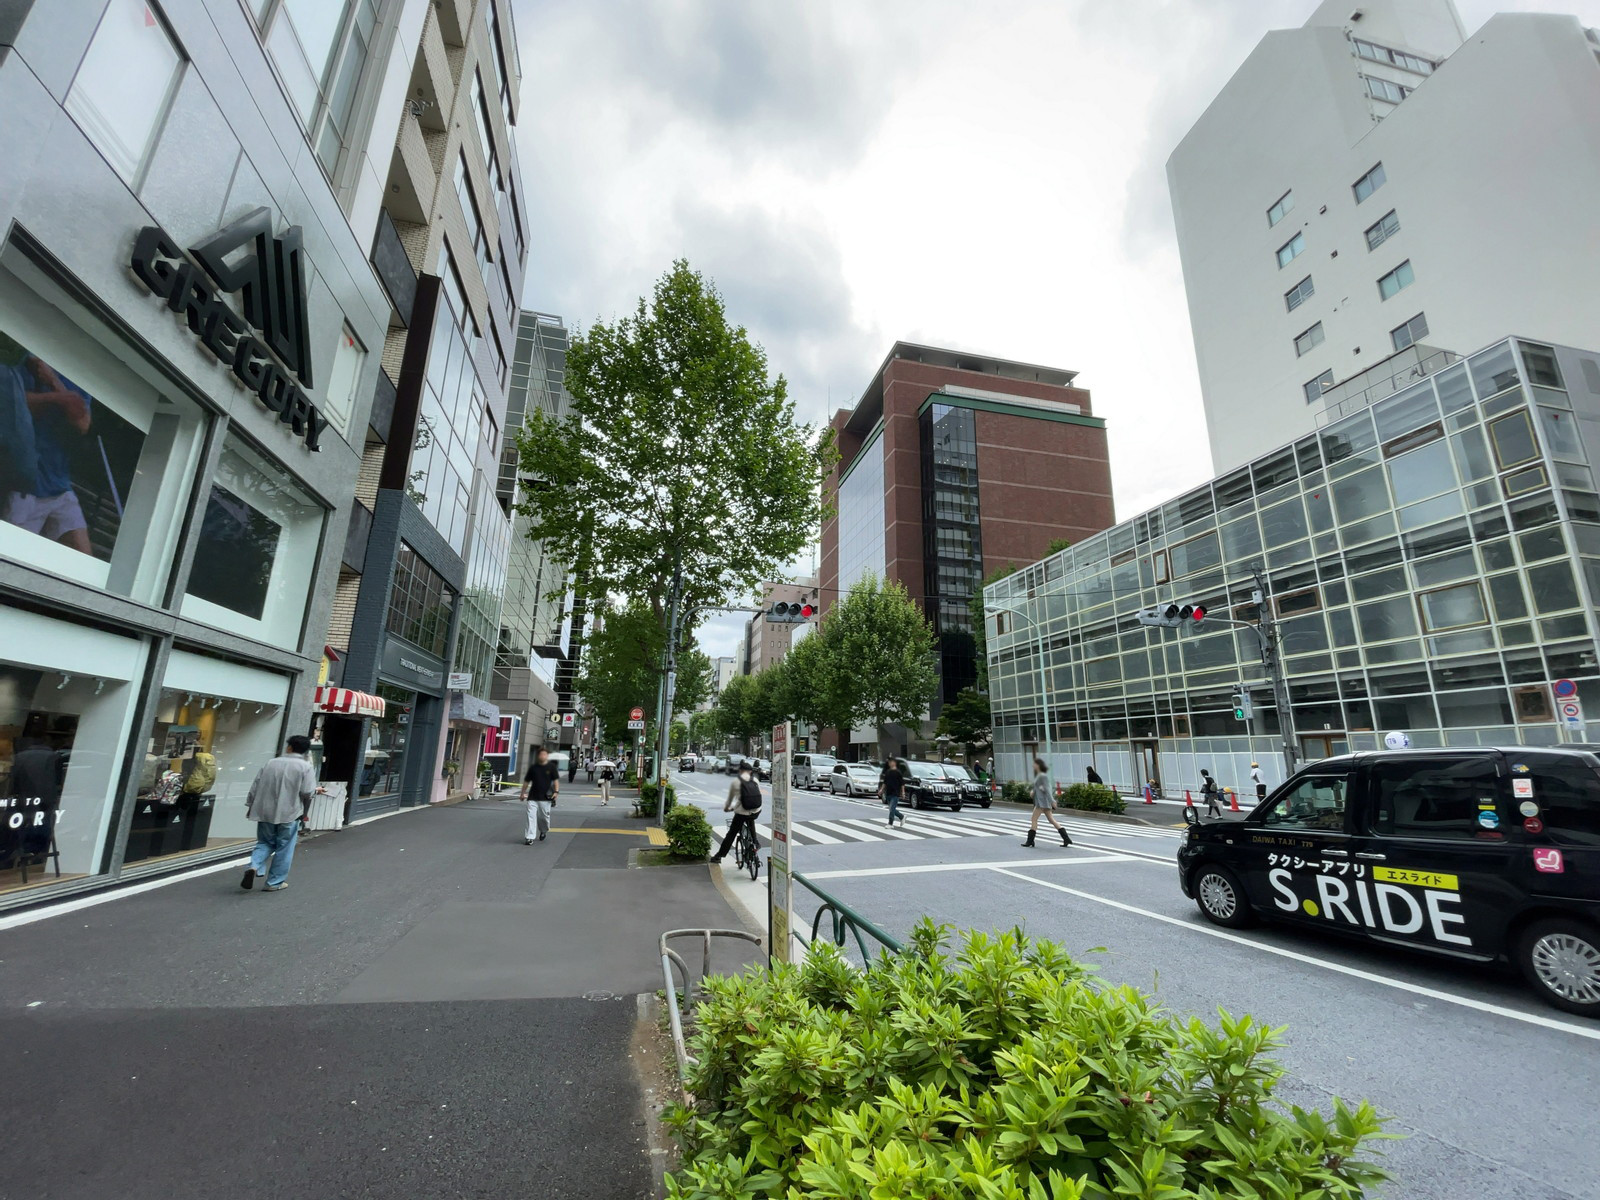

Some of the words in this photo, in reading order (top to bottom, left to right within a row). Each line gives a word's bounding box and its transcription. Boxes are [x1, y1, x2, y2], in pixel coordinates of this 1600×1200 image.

[131, 226, 328, 451] GREGORY
[26, 797, 41, 806] TO
[9, 810, 66, 829] ORY
[1252, 836, 1276, 844] DAIWA
[1278, 838, 1296, 846] TAXI
[1267, 852, 1365, 878] タクシーアプリ
[1387, 870, 1442, 885] エスライド
[1268, 868, 1473, 946] S.RIDE
